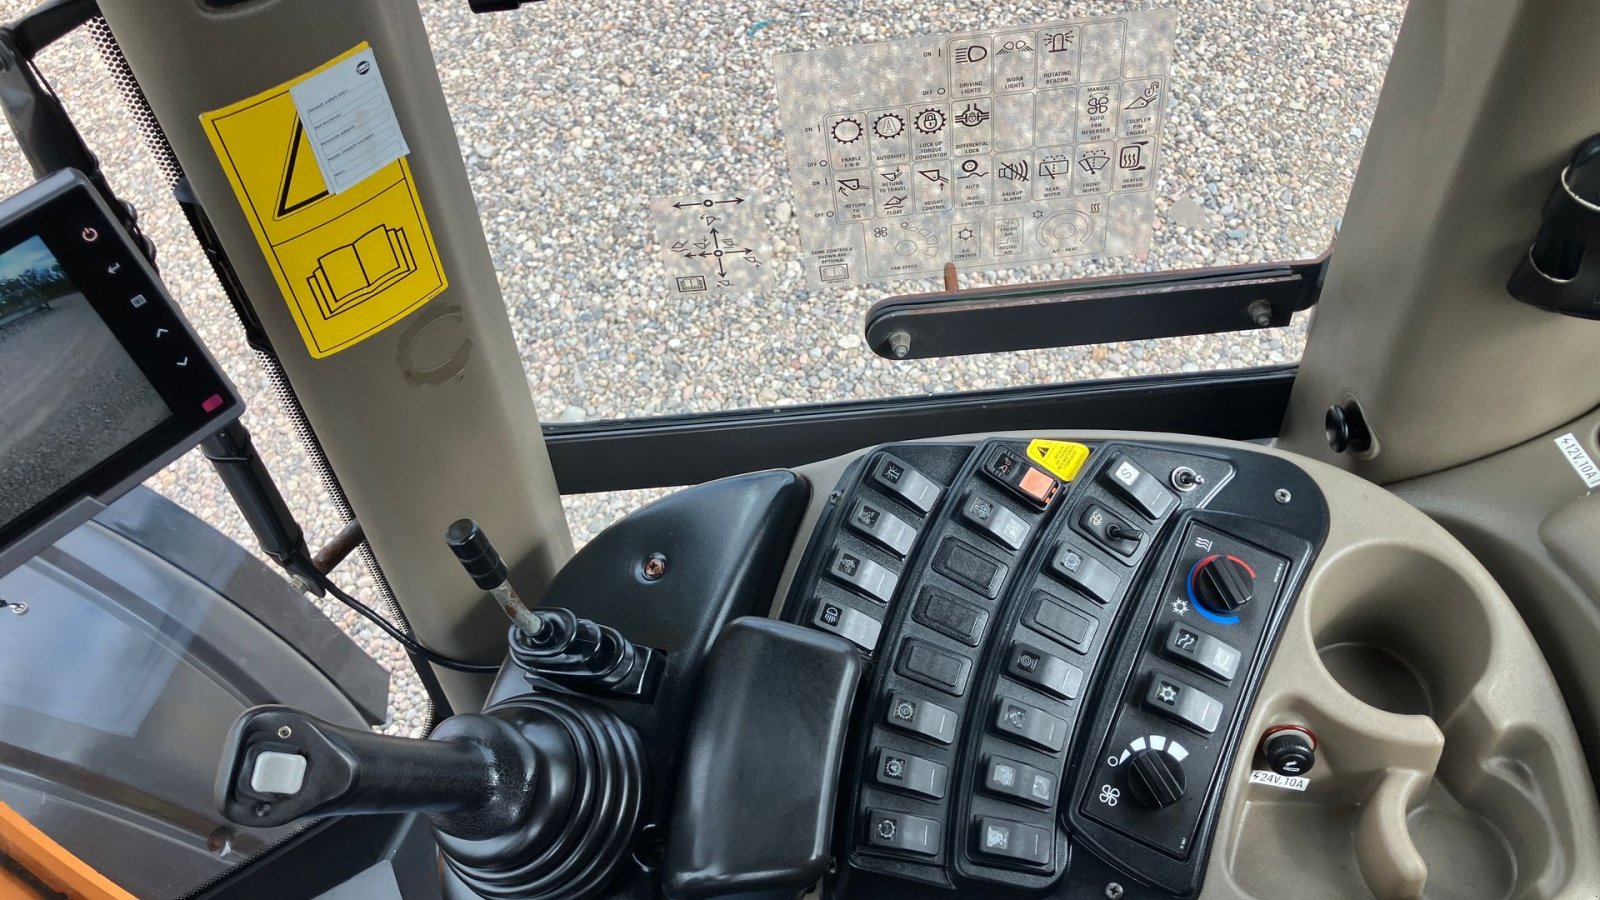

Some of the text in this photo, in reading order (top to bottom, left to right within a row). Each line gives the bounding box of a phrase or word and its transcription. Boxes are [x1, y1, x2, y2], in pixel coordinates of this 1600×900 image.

[959, 81, 983, 89] DRIVING
[1045, 77, 1069, 85] BEACON
[1004, 82, 1025, 90] LIGHTS
[1087, 85, 1111, 93] MANUAL
[955, 141, 989, 150] DIFFERENTIAL
[920, 147, 942, 155] TORQUE
[877, 153, 906, 161] AUTOSHIFT
[915, 152, 948, 161] CONVERTOR
[961, 200, 986, 208] CONTROL
[921, 205, 945, 213] CONTROL
[826, 246, 853, 255] CONTROLS
[998, 244, 1018, 252] RECIRC
[1121, 468, 1132, 479] S
